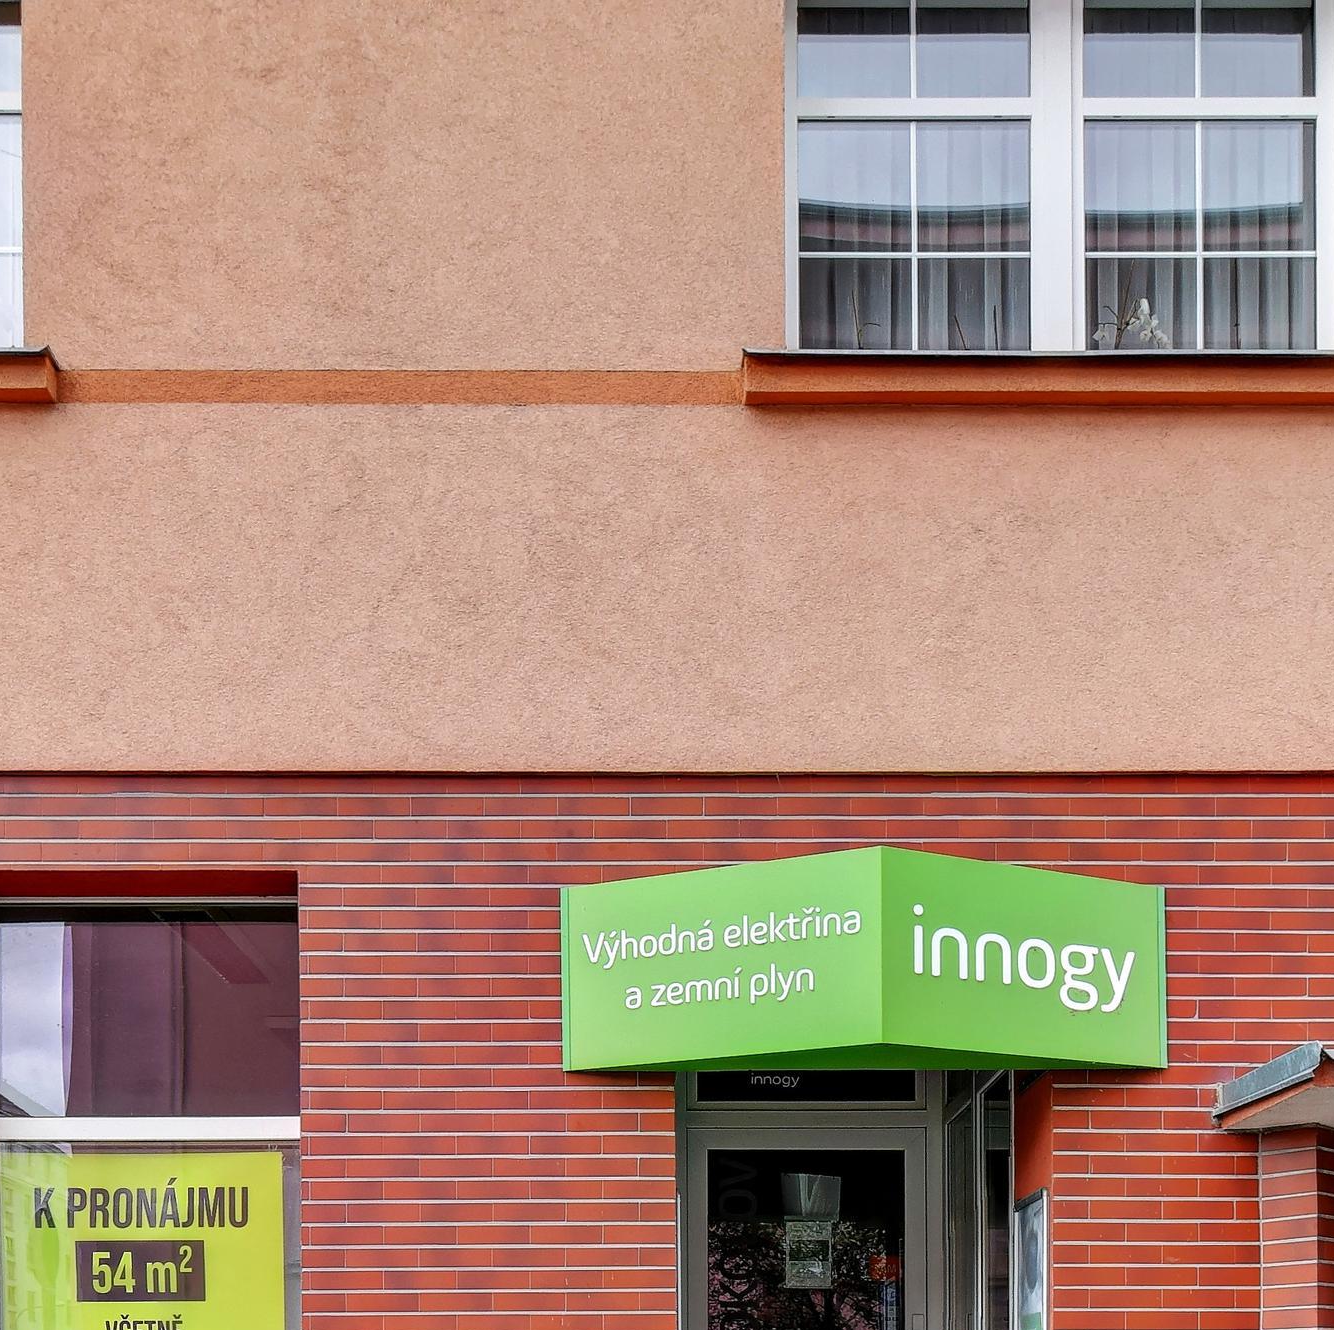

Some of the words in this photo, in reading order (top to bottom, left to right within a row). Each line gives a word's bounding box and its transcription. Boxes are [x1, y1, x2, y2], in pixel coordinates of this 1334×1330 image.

[582, 919, 714, 971] Výhodná
[723, 906, 862, 949] elektřina
[911, 903, 1137, 1014] innogy
[624, 984, 643, 1010] a
[649, 966, 741, 1008] zemní
[749, 963, 816, 1004] plyn
[750, 1072, 800, 1089] innogy
[34, 1186, 57, 1229] K
[67, 1177, 249, 1229] PRONÁJMU
[92, 1251, 136, 1294] 54
